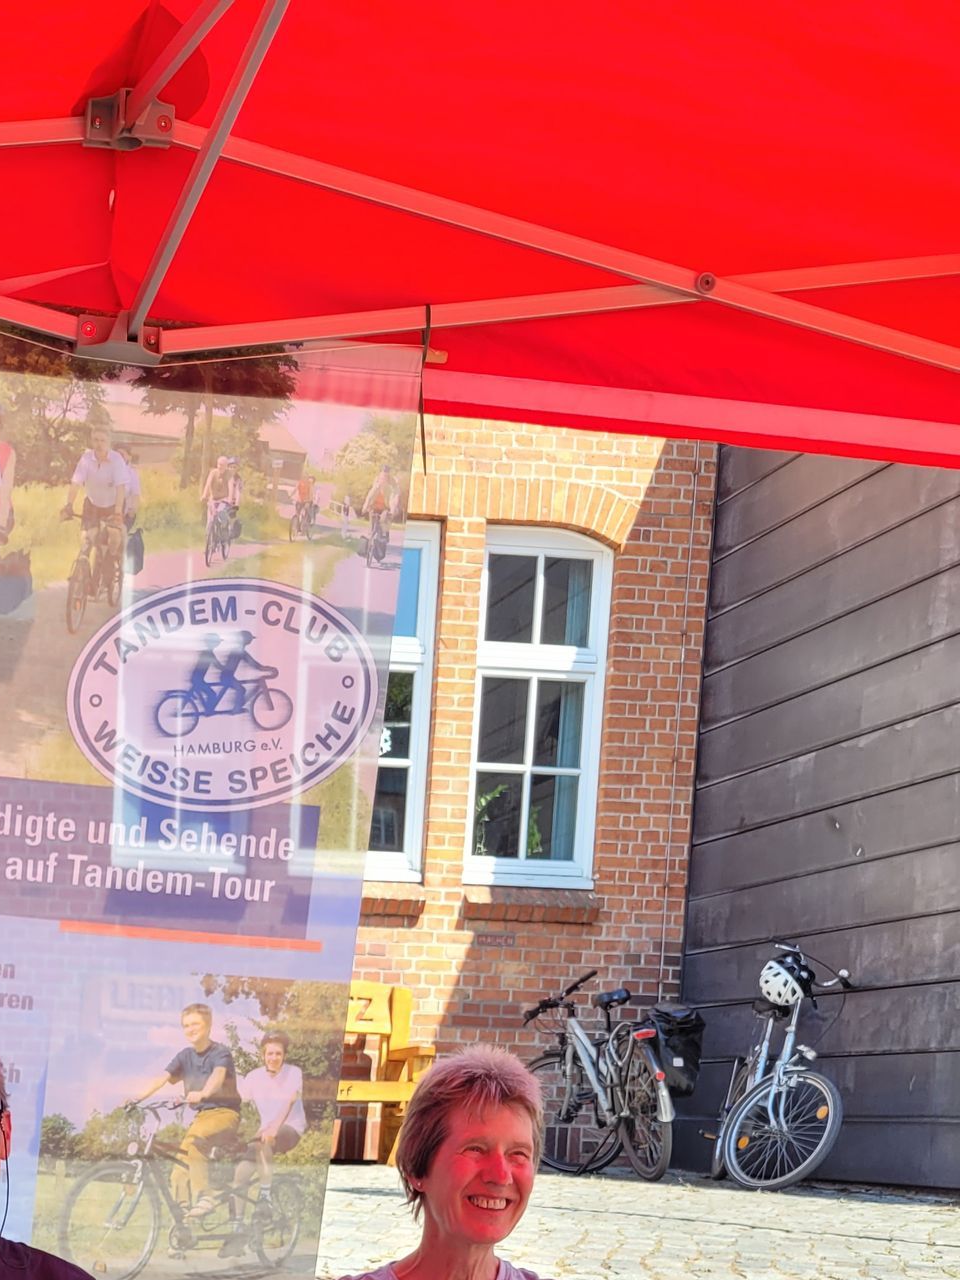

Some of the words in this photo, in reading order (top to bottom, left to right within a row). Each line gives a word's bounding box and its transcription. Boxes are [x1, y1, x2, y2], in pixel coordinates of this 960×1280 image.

[93, 596, 350, 676] TANDEM-CLUB
[94, 720, 213, 795] WEISSE
[228, 701, 355, 795] SPEICHE
[173, 738, 256, 758] HAMBURG
[261, 737, 283, 751] e.V.
[87, 818, 146, 849] und
[158, 819, 296, 861] Sehende
[5, 850, 58, 884] auf
[68, 854, 276, 903] Tandem-Tour
